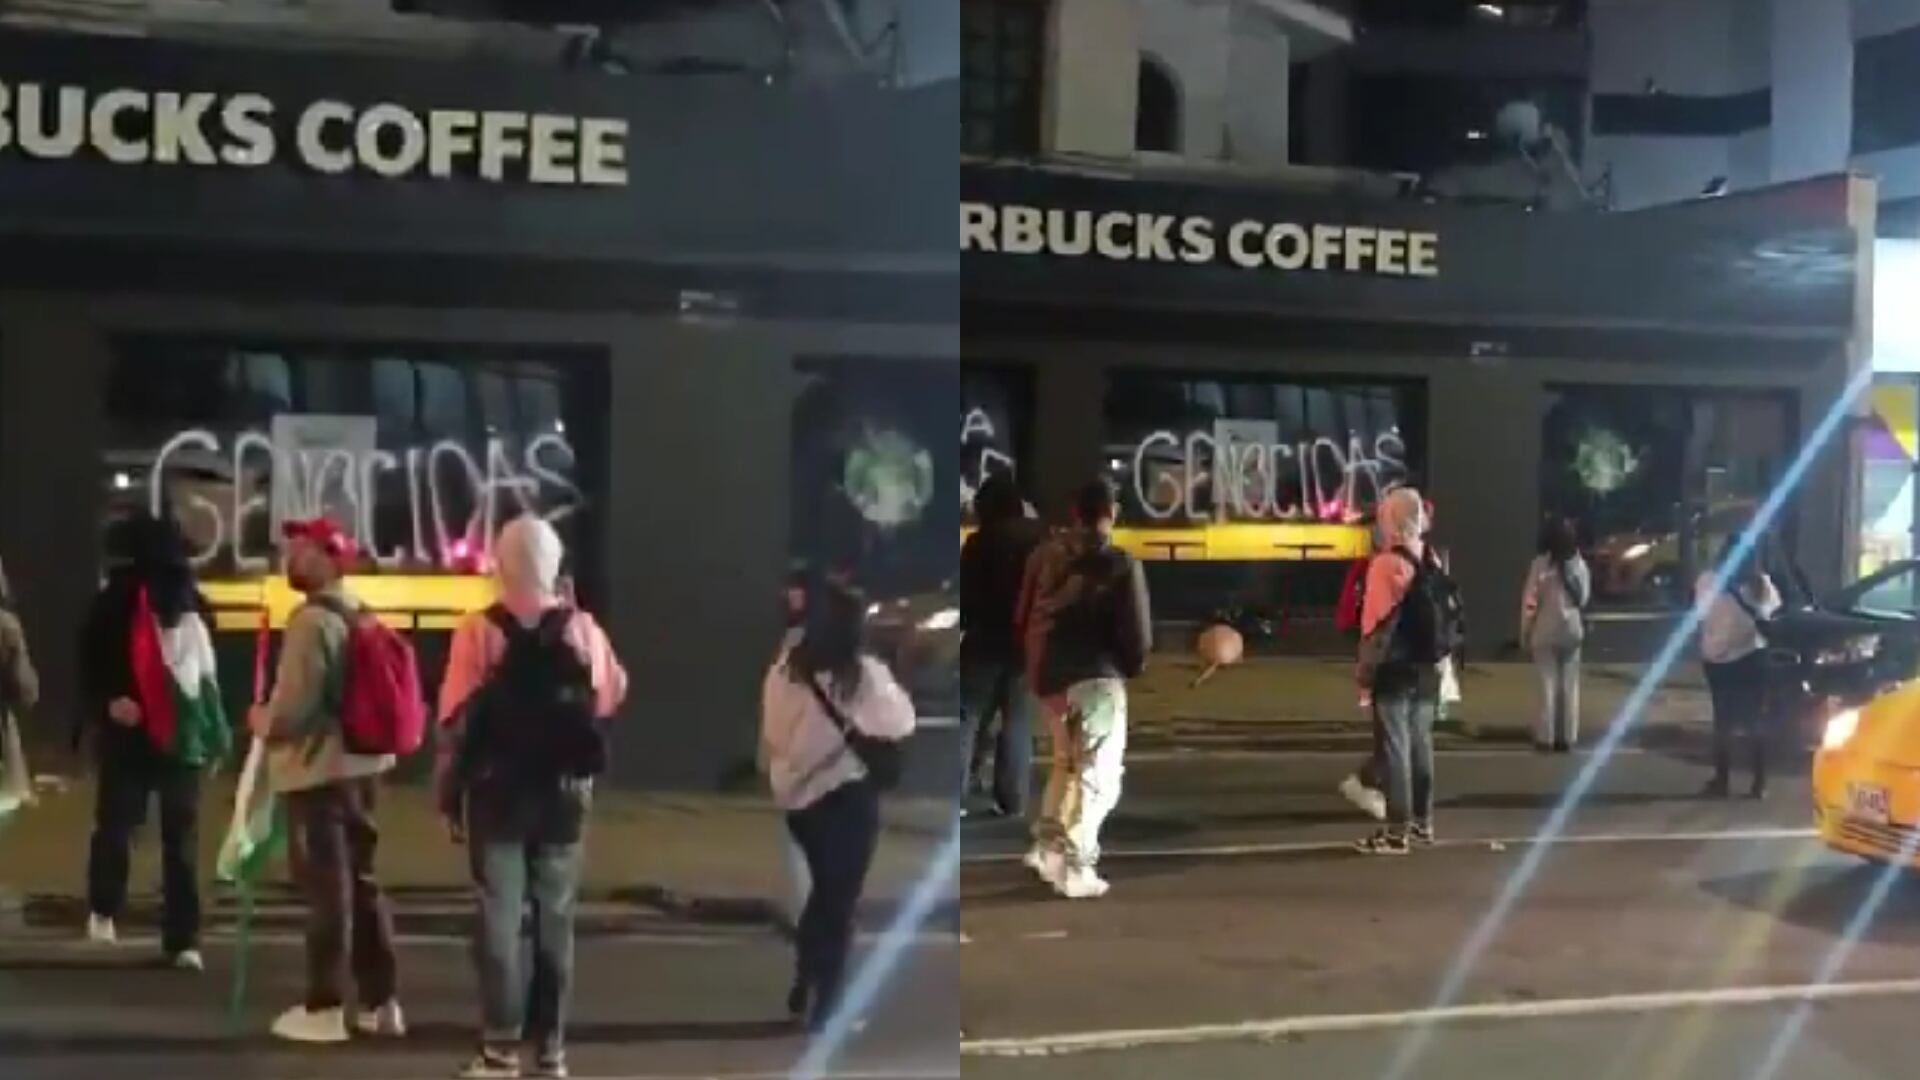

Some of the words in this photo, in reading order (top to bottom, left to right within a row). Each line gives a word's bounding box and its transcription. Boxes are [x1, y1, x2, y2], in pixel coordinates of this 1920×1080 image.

[0, 83, 275, 166] UCKS
[297, 101, 629, 186] COFFEE
[960, 202, 1214, 263] RBUCKS
[1228, 220, 1439, 276] COFFEE
